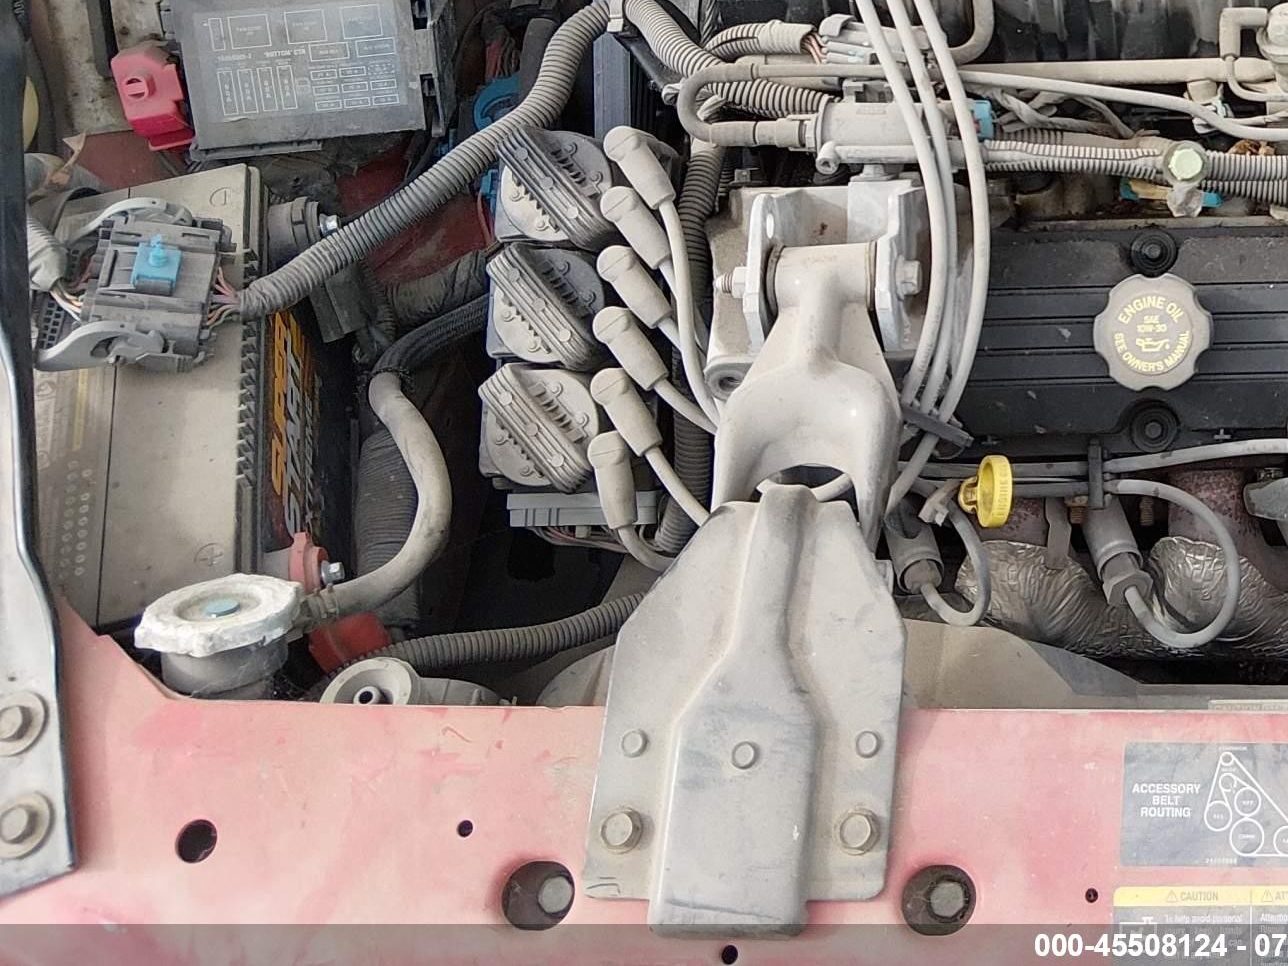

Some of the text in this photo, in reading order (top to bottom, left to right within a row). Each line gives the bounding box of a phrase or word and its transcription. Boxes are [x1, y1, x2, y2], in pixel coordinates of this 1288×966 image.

[1118, 295, 1185, 324] ENGINE OIL
[1143, 315, 1160, 324] SAE
[1136, 324, 1167, 333] 10W-30
[1114, 330, 1190, 372] SEE OWNER'S MANUAL
[271, 312, 287, 496] SUPER
[284, 331, 301, 537] START
[1132, 783, 1201, 794] ACCESSORY
[1152, 795, 1180, 805] BELT
[1140, 807, 1191, 818] ROUTING
[1180, 891, 1219, 901] CAUTION
